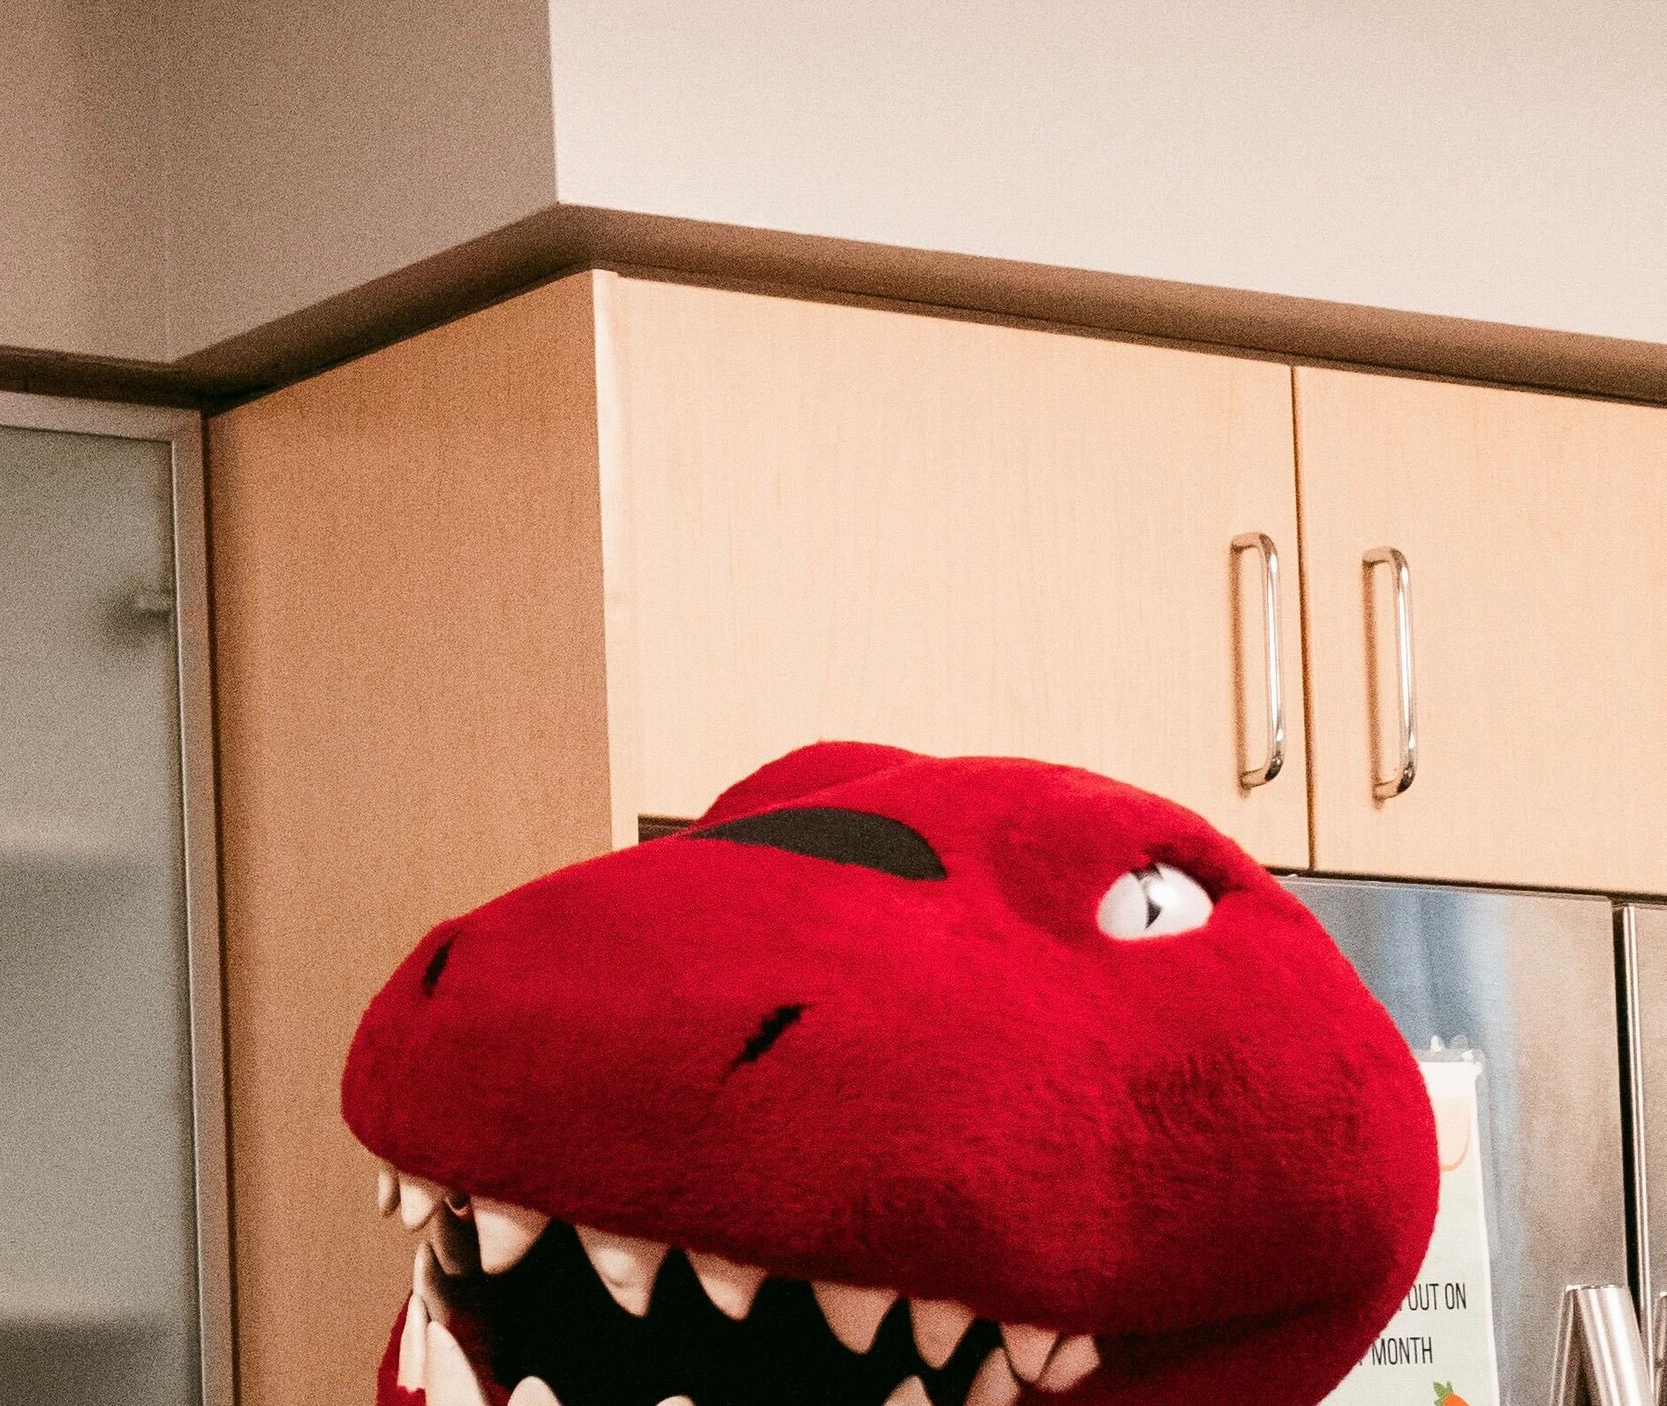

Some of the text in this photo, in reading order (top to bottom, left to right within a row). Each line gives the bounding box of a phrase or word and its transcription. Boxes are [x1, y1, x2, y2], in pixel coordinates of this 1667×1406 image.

[1407, 1282, 1467, 1311] OUT ON
[1371, 1336, 1433, 1366] MONTH
